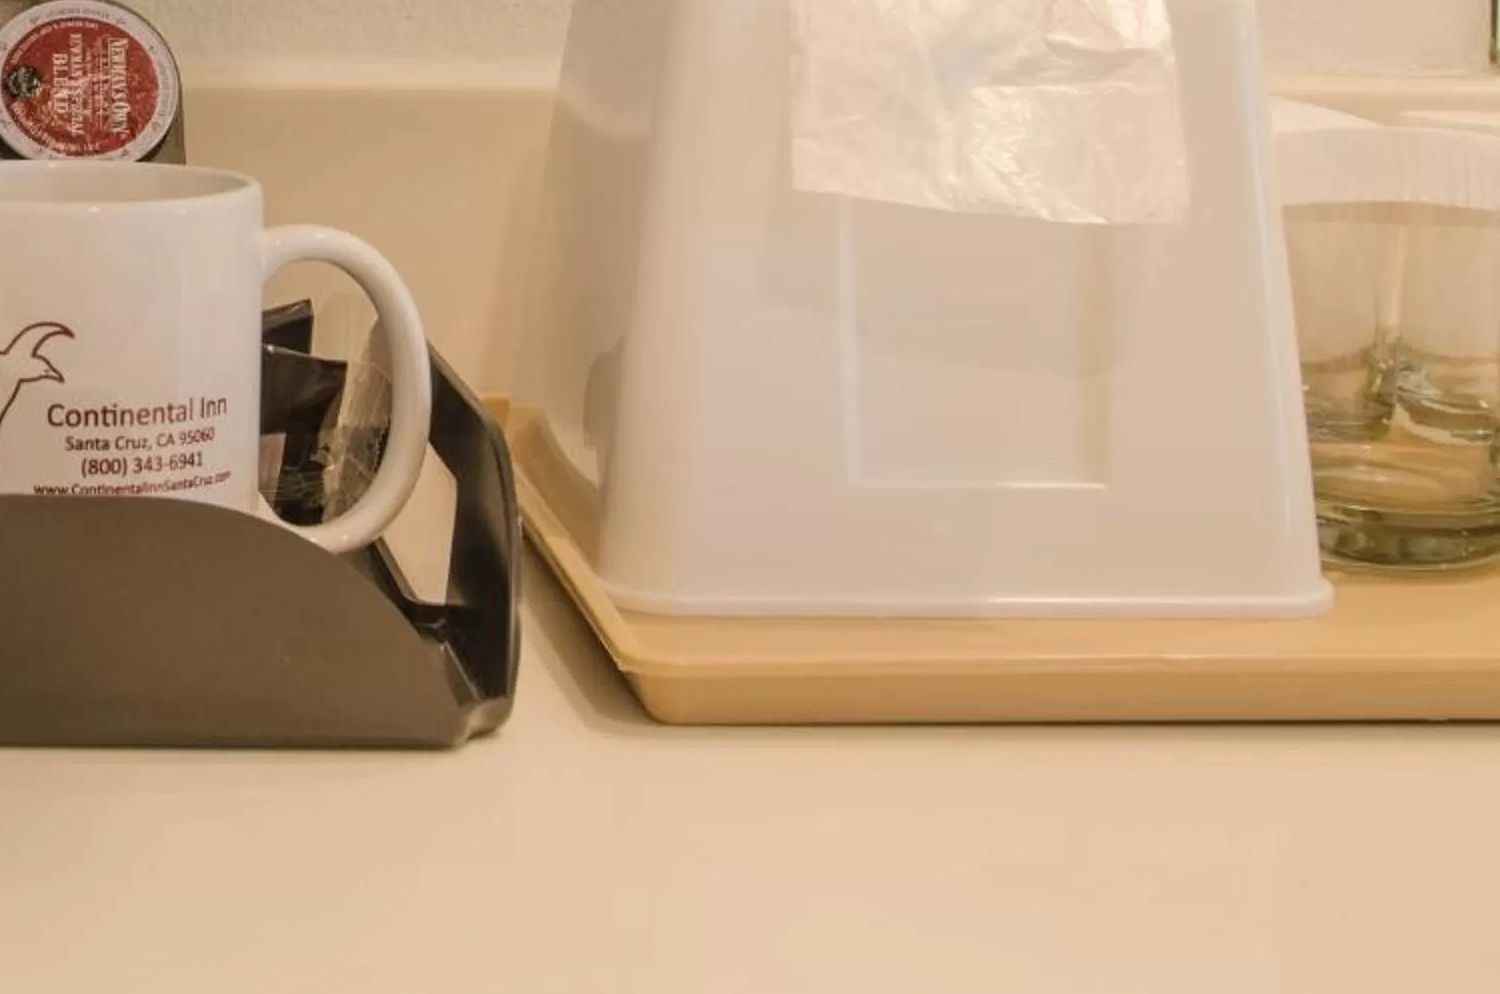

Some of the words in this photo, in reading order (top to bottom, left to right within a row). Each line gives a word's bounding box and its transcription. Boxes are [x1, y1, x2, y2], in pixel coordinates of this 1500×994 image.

[51, 52, 71, 113] BLEND
[47, 398, 194, 427] Continental
[200, 396, 228, 419] Inn
[65, 435, 110, 451] Santa
[115, 434, 152, 451] Cruz,
[156, 433, 175, 447] CA
[179, 427, 215, 446] 95060
[80, 457, 128, 478] (800)
[133, 452, 203, 475] 343-6941
